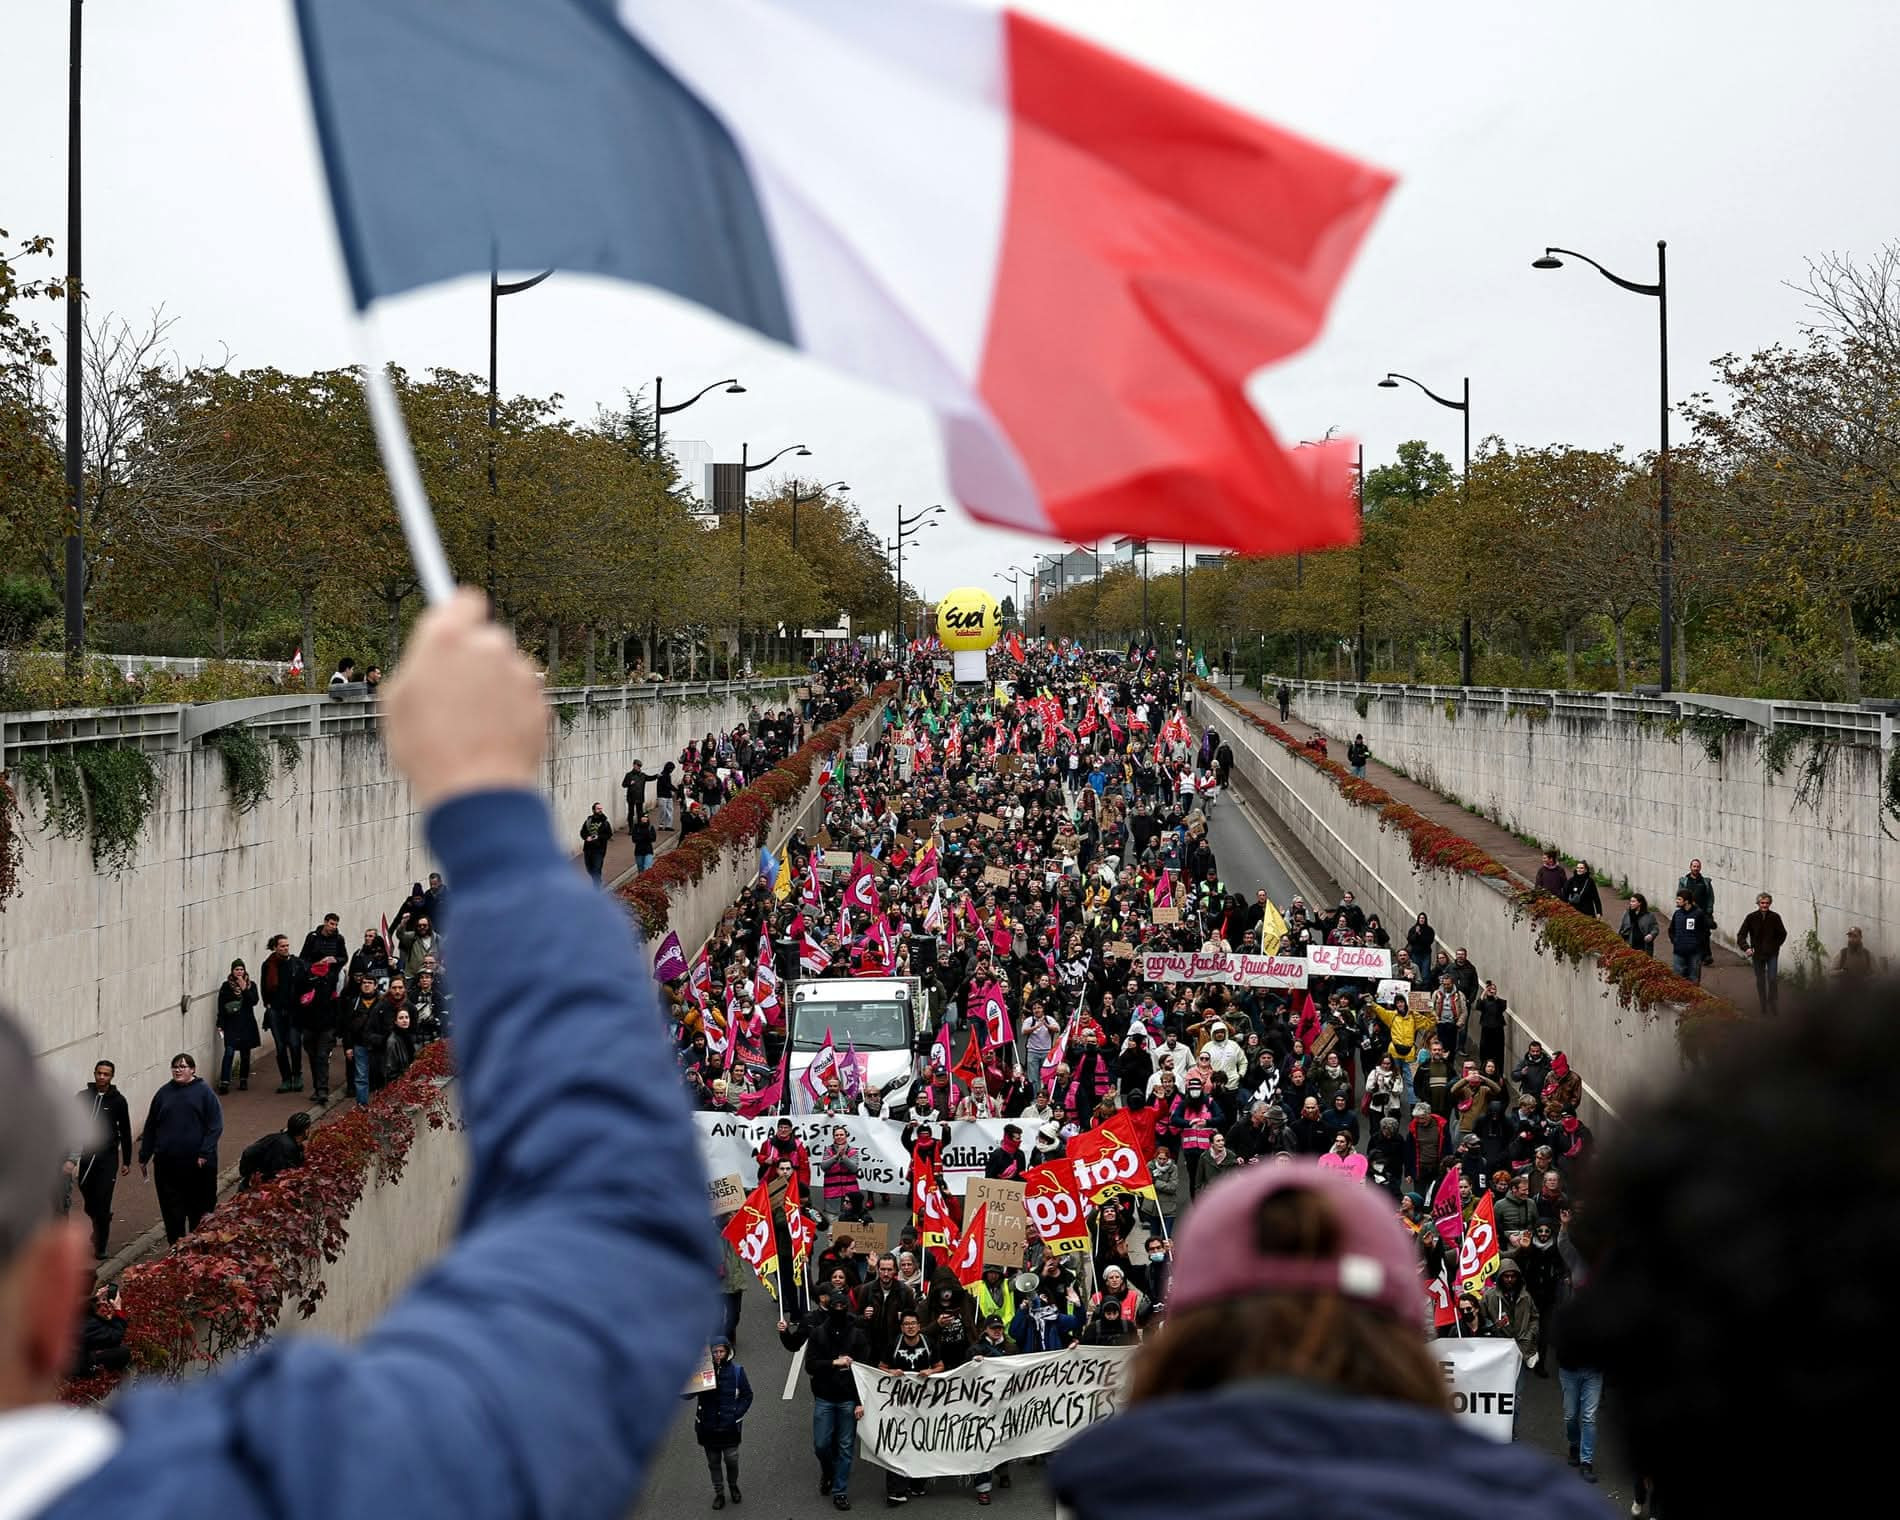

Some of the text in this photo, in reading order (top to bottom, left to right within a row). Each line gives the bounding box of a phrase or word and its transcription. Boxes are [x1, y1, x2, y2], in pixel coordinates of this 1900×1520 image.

[1313, 948, 1330, 964] de
[990, 1201, 1006, 1212] PAS
[1448, 1391, 1514, 1415] OITE
[874, 1418, 908, 1455] NOS
[911, 1412, 997, 1454] QUARTIERS
